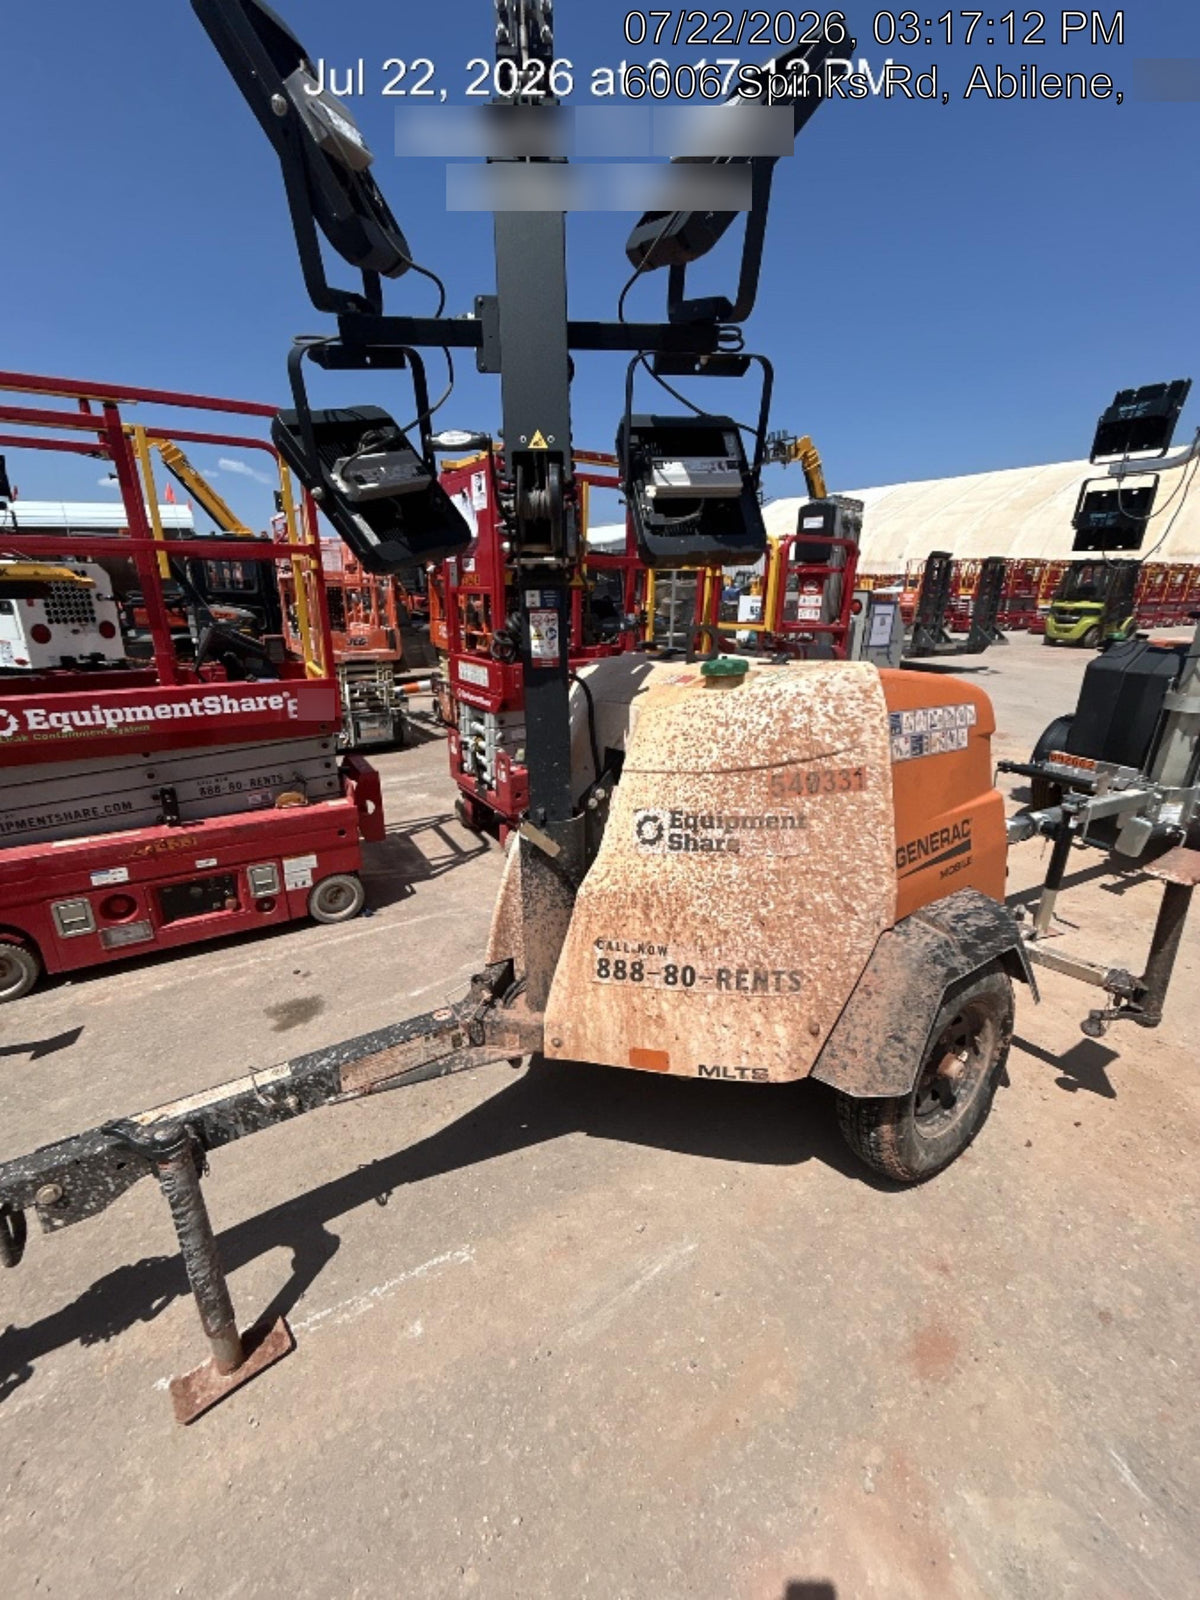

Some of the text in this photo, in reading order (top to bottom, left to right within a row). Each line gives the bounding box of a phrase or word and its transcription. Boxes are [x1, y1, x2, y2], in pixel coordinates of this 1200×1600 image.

[23, 694, 286, 733] EquipmentShare
[669, 810, 807, 833] Equipment
[896, 818, 972, 869] GENERAC
[940, 856, 973, 879] MOBILE
[596, 939, 668, 957] CALL NOW
[597, 958, 801, 992] 888-80-RENTS
